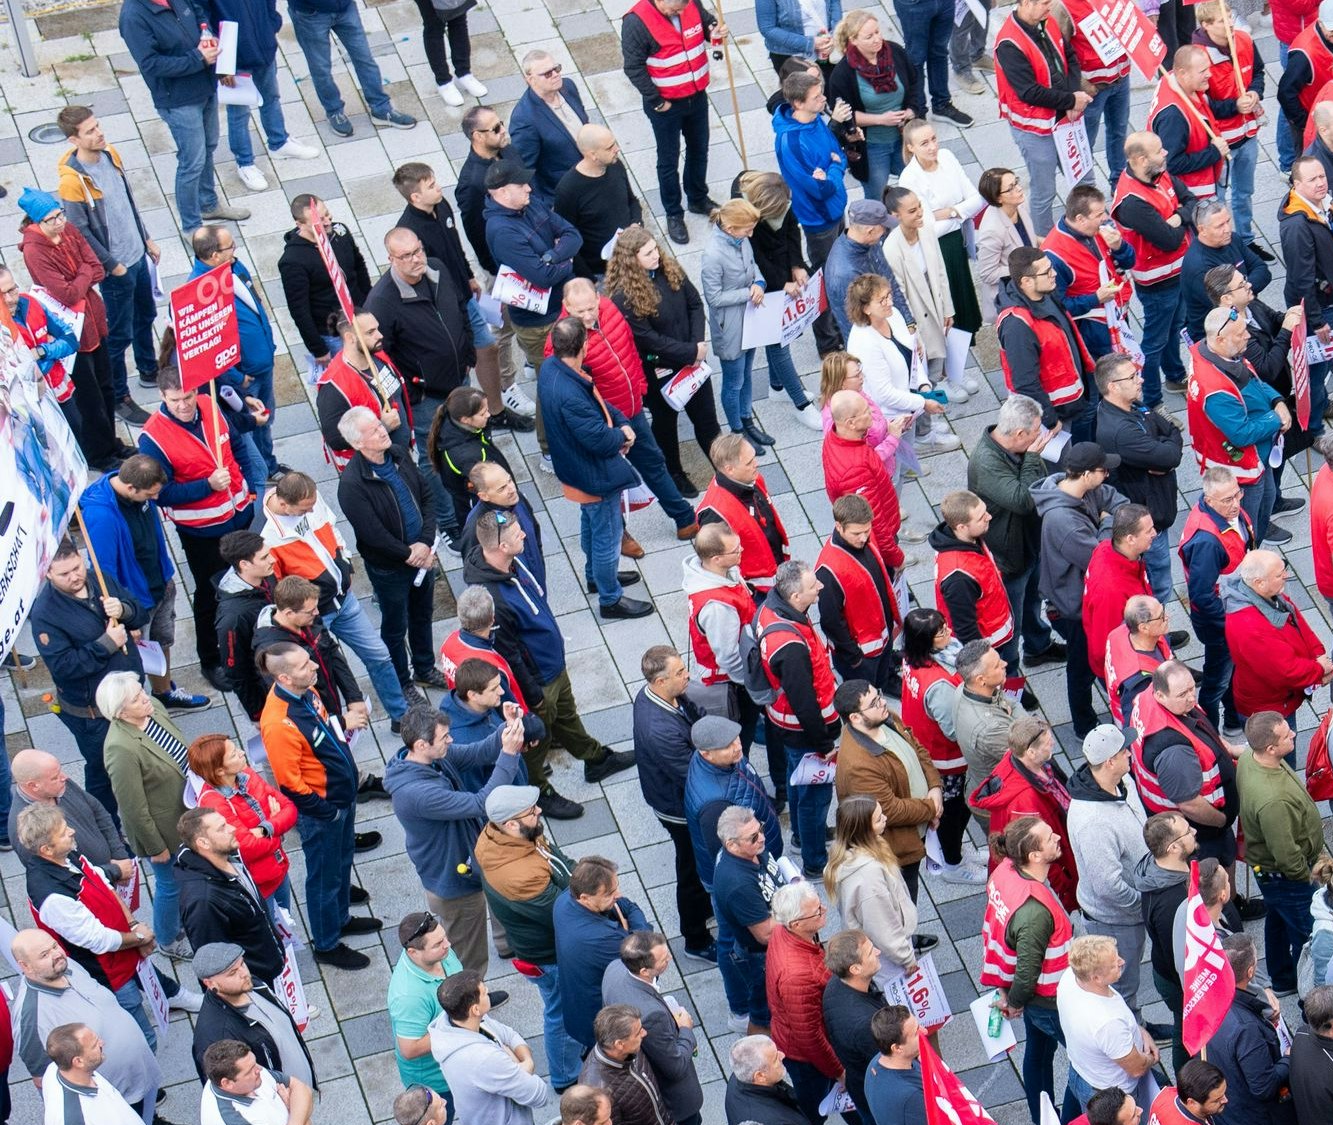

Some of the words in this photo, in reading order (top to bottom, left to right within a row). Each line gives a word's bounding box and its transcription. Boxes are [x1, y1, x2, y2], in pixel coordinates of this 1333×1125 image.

[178, 302, 195, 317] WIR
[179, 302, 217, 328] KÄMPFEN
[181, 323, 195, 339] FÜR
[197, 307, 233, 334] UNSEREN
[181, 321, 227, 350] KOLLEKTIV-
[183, 335, 222, 361] VERTRAG!
[215, 344, 238, 370] gpa
